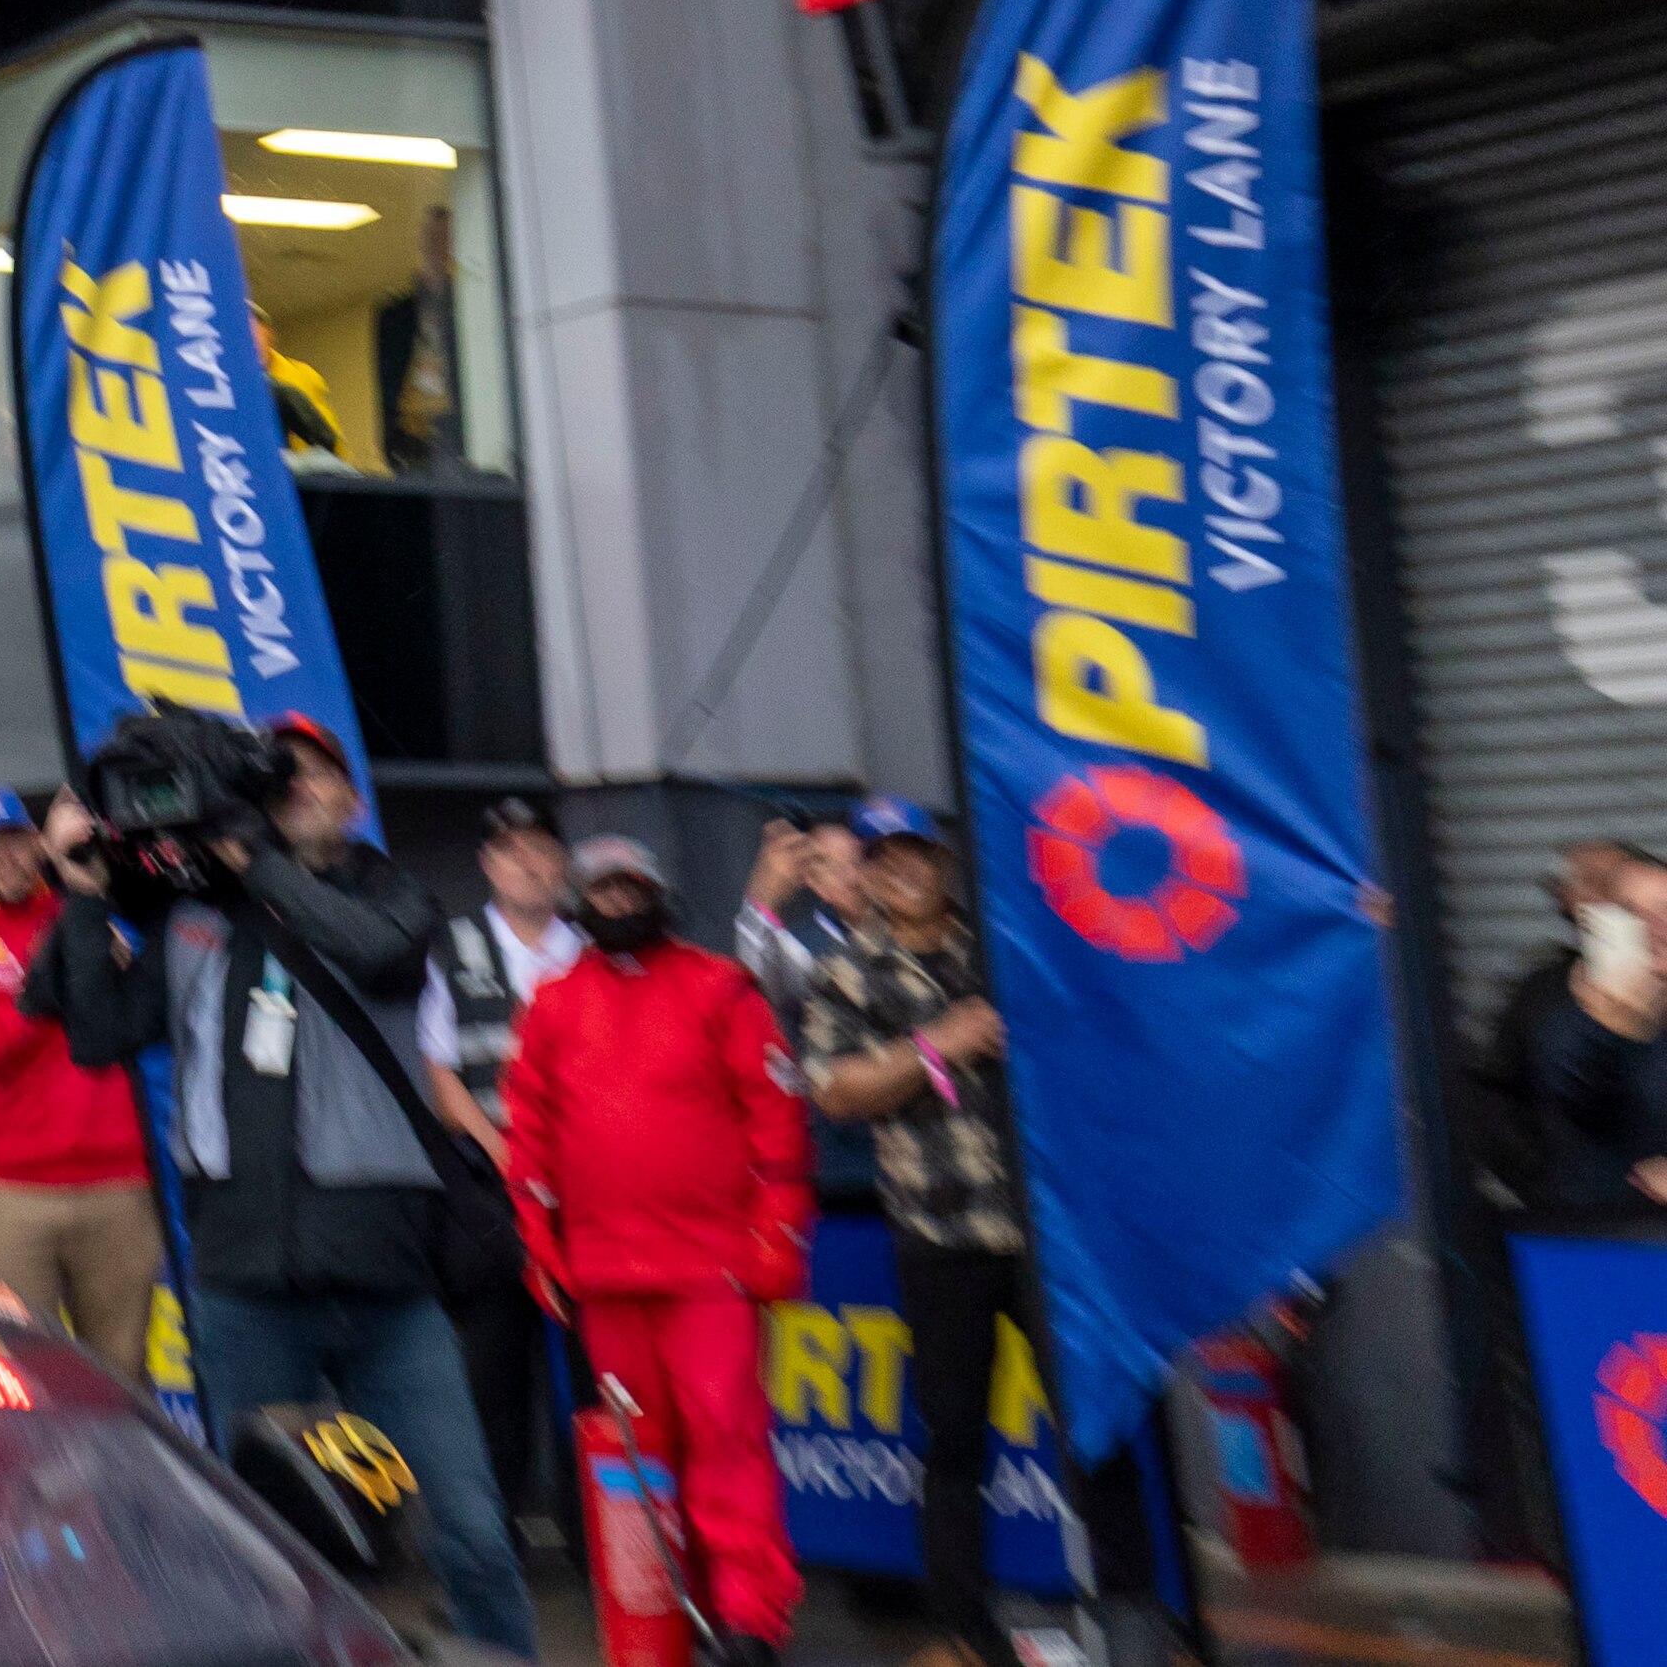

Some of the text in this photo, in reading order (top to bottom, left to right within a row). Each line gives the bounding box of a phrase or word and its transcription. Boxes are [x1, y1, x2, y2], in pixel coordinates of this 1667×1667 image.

[159, 256, 303, 679] VICTORY LANE
[1011, 50, 1211, 770] PIRTEK
[1181, 56, 1287, 593] VICTORY LANE
